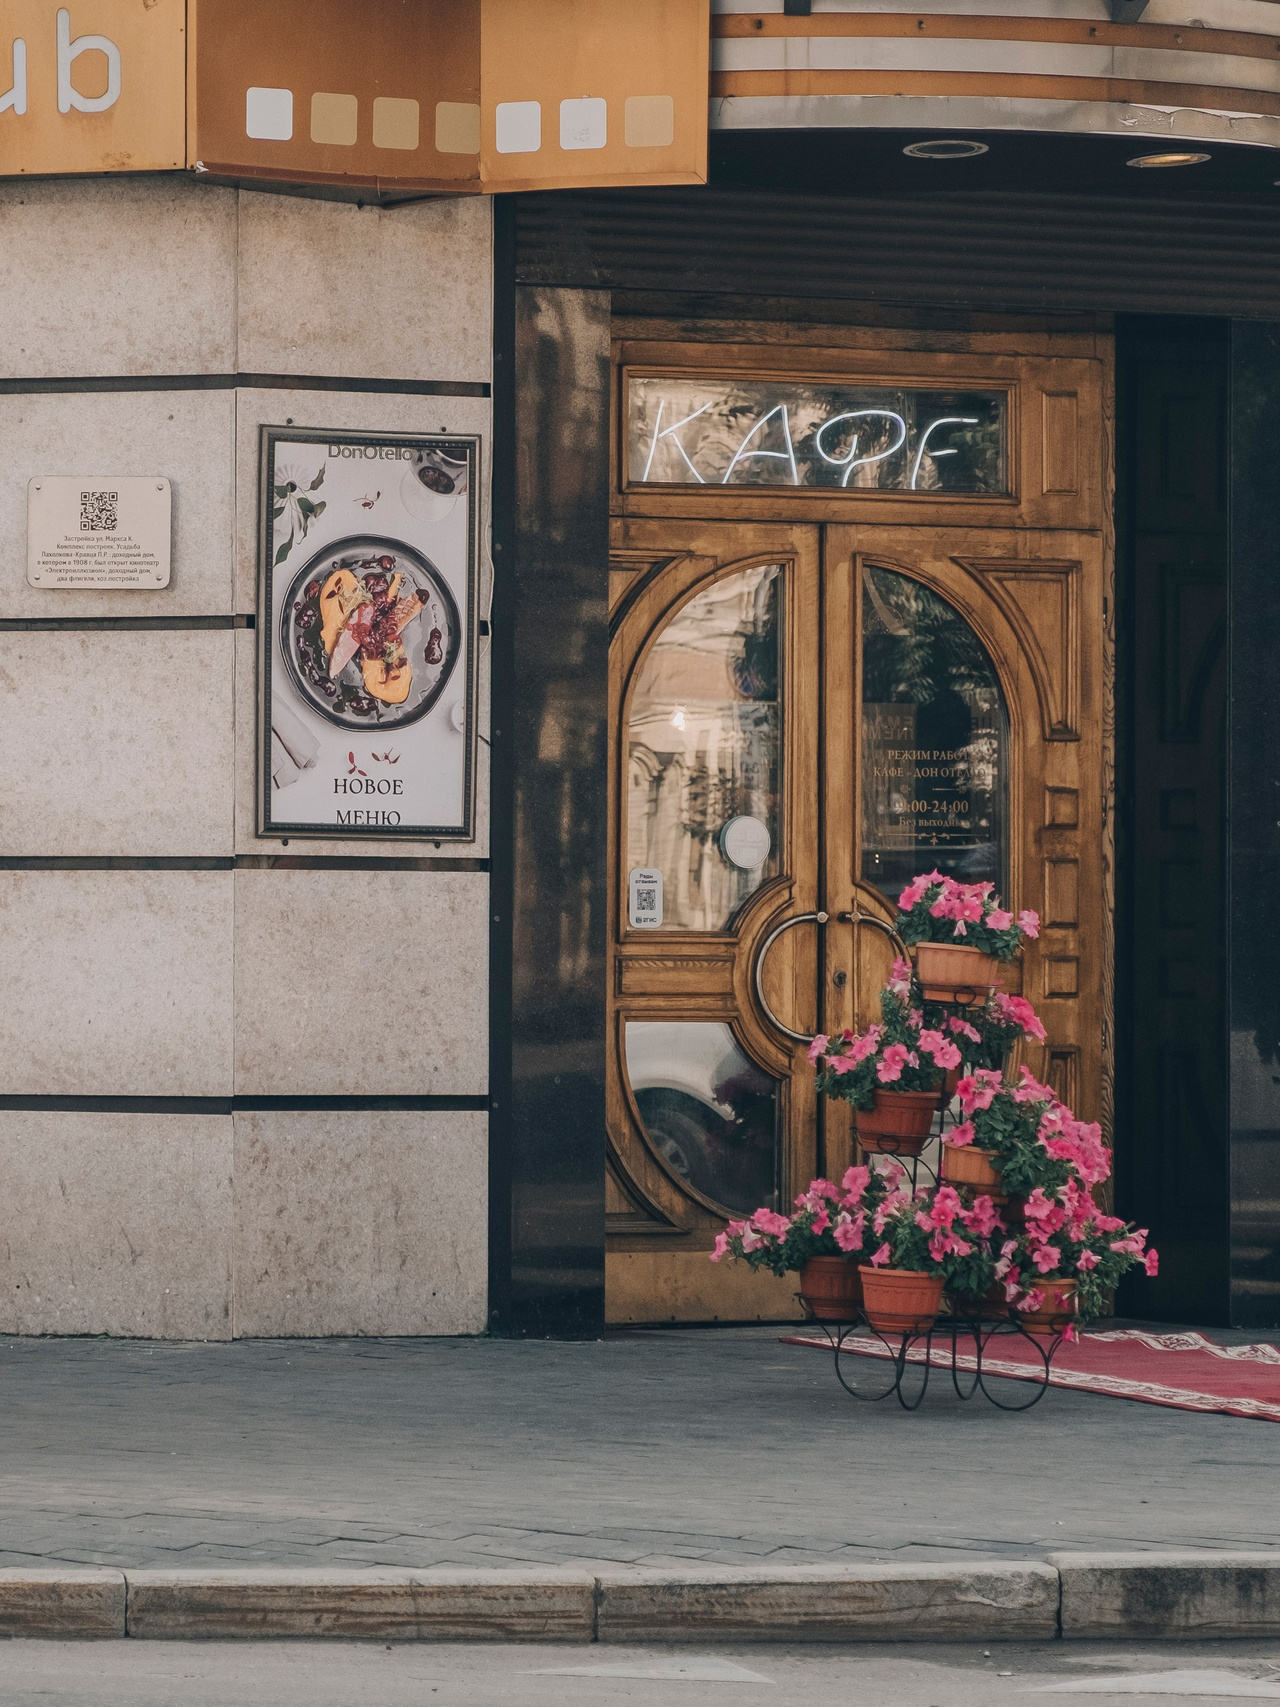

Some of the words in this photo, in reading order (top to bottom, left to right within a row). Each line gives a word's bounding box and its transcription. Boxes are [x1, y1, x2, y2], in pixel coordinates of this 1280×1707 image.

[63, 535, 95, 543] Застройка
[105, 535, 127, 543] Маркса
[111, 551, 142, 559] доходный
[129, 560, 160, 568] кинотеатр
[107, 567, 138, 575] доходный
[887, 749, 932, 761] РЕЖИМ
[873, 766, 905, 778] КАФЕ
[333, 777, 404, 796] НОВОЕ
[336, 809, 402, 826] МЕНЮ
[898, 816, 917, 827] Без
